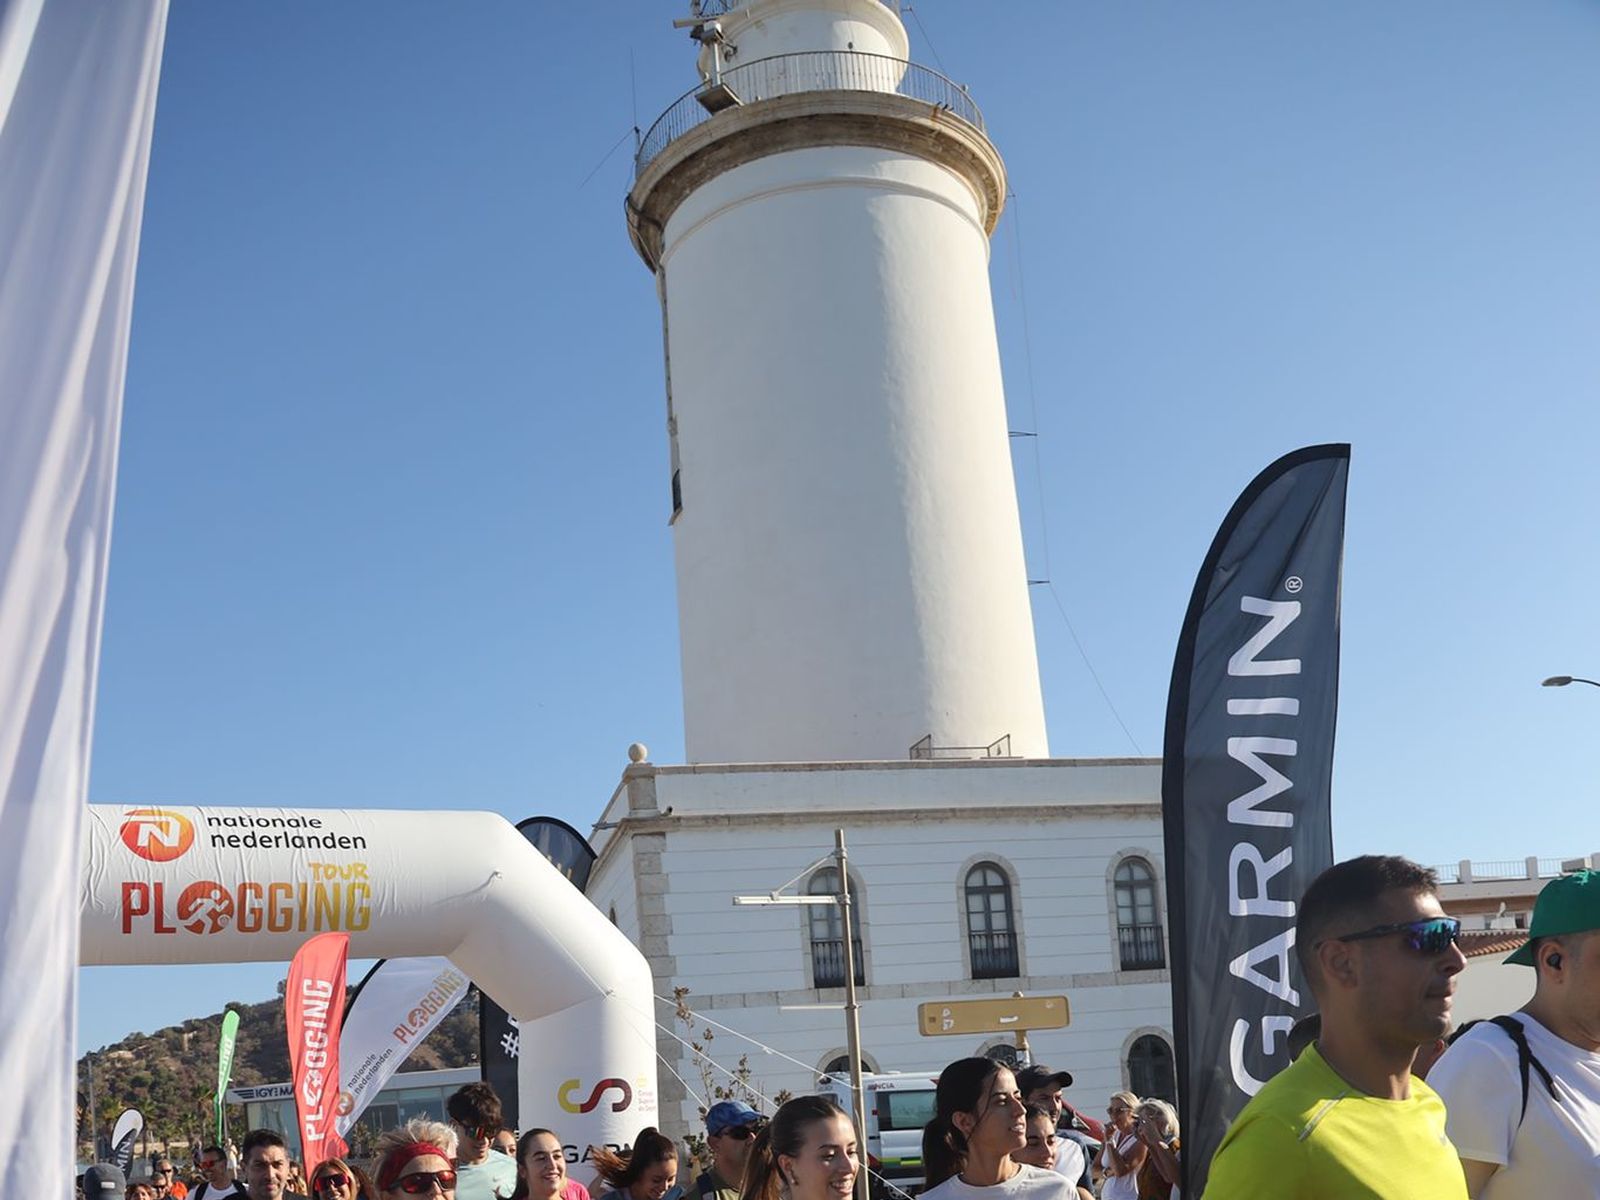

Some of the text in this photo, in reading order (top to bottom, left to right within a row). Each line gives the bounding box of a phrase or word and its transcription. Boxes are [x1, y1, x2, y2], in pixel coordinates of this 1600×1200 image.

[207, 816, 322, 829] nationale
[211, 832, 367, 849] nederlanden
[309, 862, 370, 881] TOUR
[121, 880, 371, 935] PLOGGING
[303, 979, 332, 1141] PLOGGING
